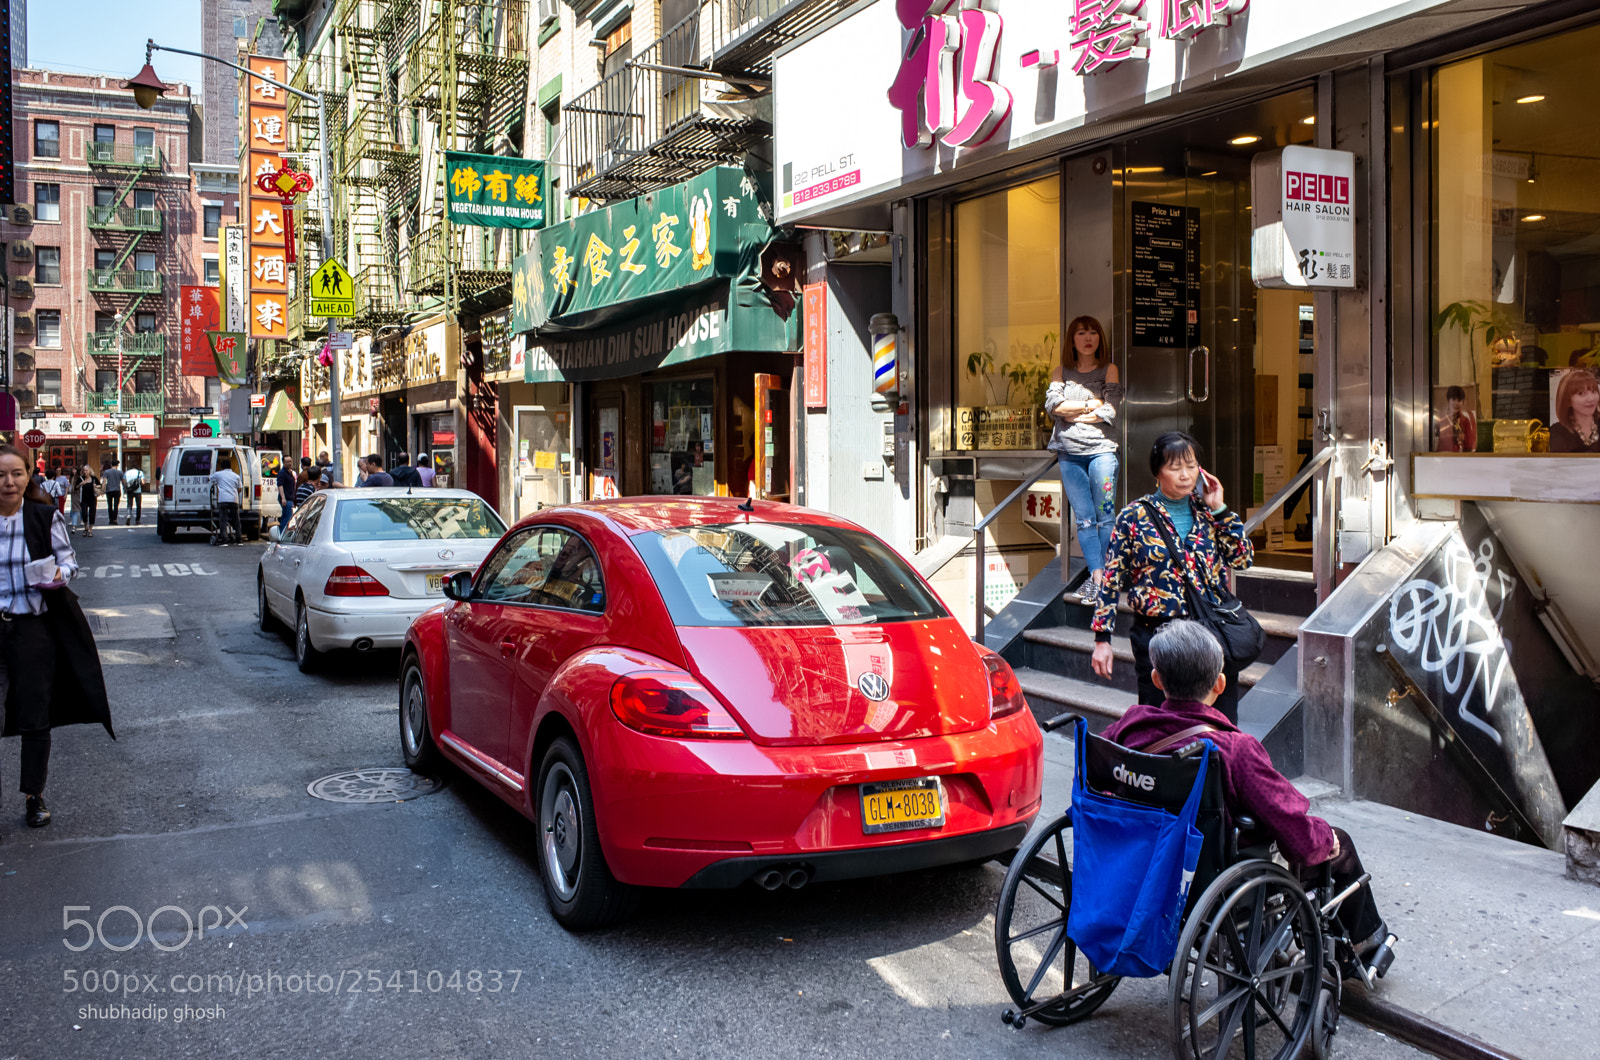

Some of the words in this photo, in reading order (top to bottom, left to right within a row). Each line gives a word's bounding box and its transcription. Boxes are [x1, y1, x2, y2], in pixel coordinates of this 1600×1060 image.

[450, 167, 543, 204] 佛有緣
[794, 171, 809, 186] 22
[811, 161, 836, 181] PELL
[794, 174, 858, 203] 212.233.6789
[1287, 173, 1348, 202] PELL
[451, 202, 492, 217] VEGETARIAN
[493, 206, 505, 217] DIM
[506, 207, 519, 218] SUM
[520, 208, 543, 220] HOUSE
[1151, 206, 1167, 216] Price
[1169, 208, 1180, 217] List
[1286, 202, 1311, 213] HAIR
[1315, 204, 1350, 216] SALON
[549, 212, 682, 295] 素食之家
[189, 288, 204, 320] 華埠
[316, 303, 350, 314] AHEAD
[532, 332, 605, 371] VEGETARIAN
[607, 330, 632, 366] DIM
[634, 321, 664, 357] SUM
[666, 302, 720, 349] HOUSE
[59, 420, 137, 433] 優の良品
[961, 410, 991, 424] CANDY
[24, 434, 45, 443] STOP
[193, 428, 212, 436] STOP
[1026, 493, 1060, 518] 香港
[1112, 763, 1155, 792] drive
[903, 791, 935, 817] 8038
[883, 819, 926, 831] JENNINGS
